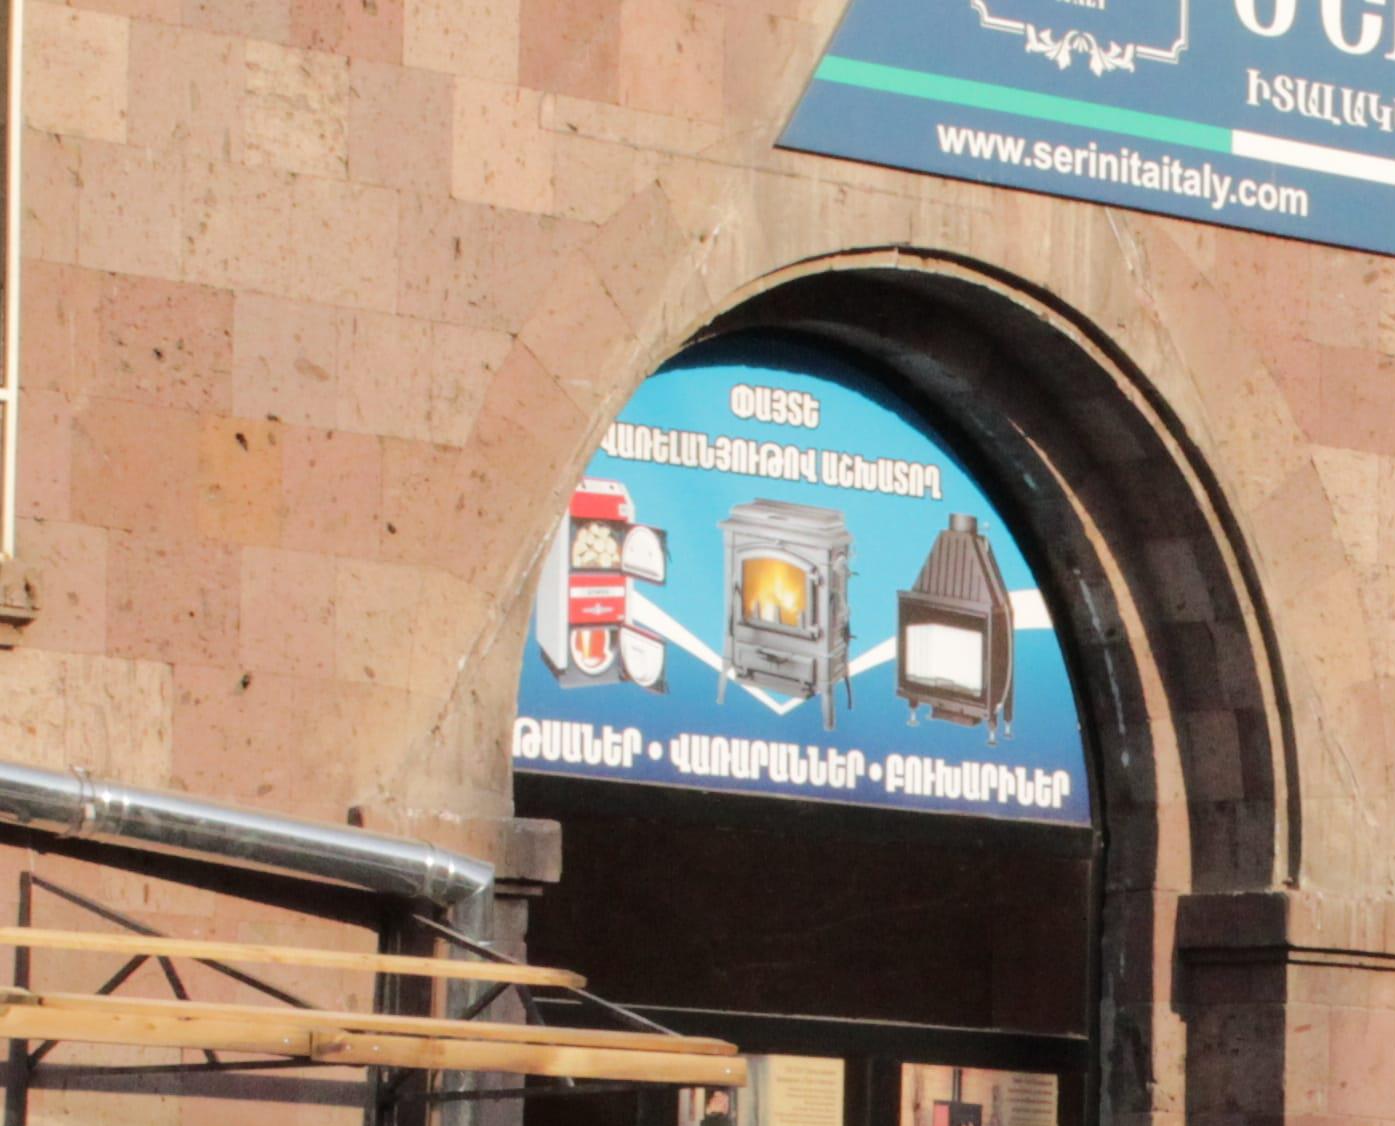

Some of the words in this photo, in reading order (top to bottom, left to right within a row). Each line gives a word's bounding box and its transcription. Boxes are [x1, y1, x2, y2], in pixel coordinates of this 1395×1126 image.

[937, 124, 1308, 217] www.serinitaitaly.com
[730, 383, 821, 429] ՓԱՅՏԵ
[601, 421, 818, 484] ՎԱՌԵԼԱՆՅՈՒԹՈՎ
[822, 450, 943, 500] ԱՇԽԱՏՈՂ
[669, 733, 866, 789] ՎԱՌԱՐԱՆՆԵՐ
[885, 753, 1070, 809] ԲՈՒԽԱՐԻՆԵՐ
